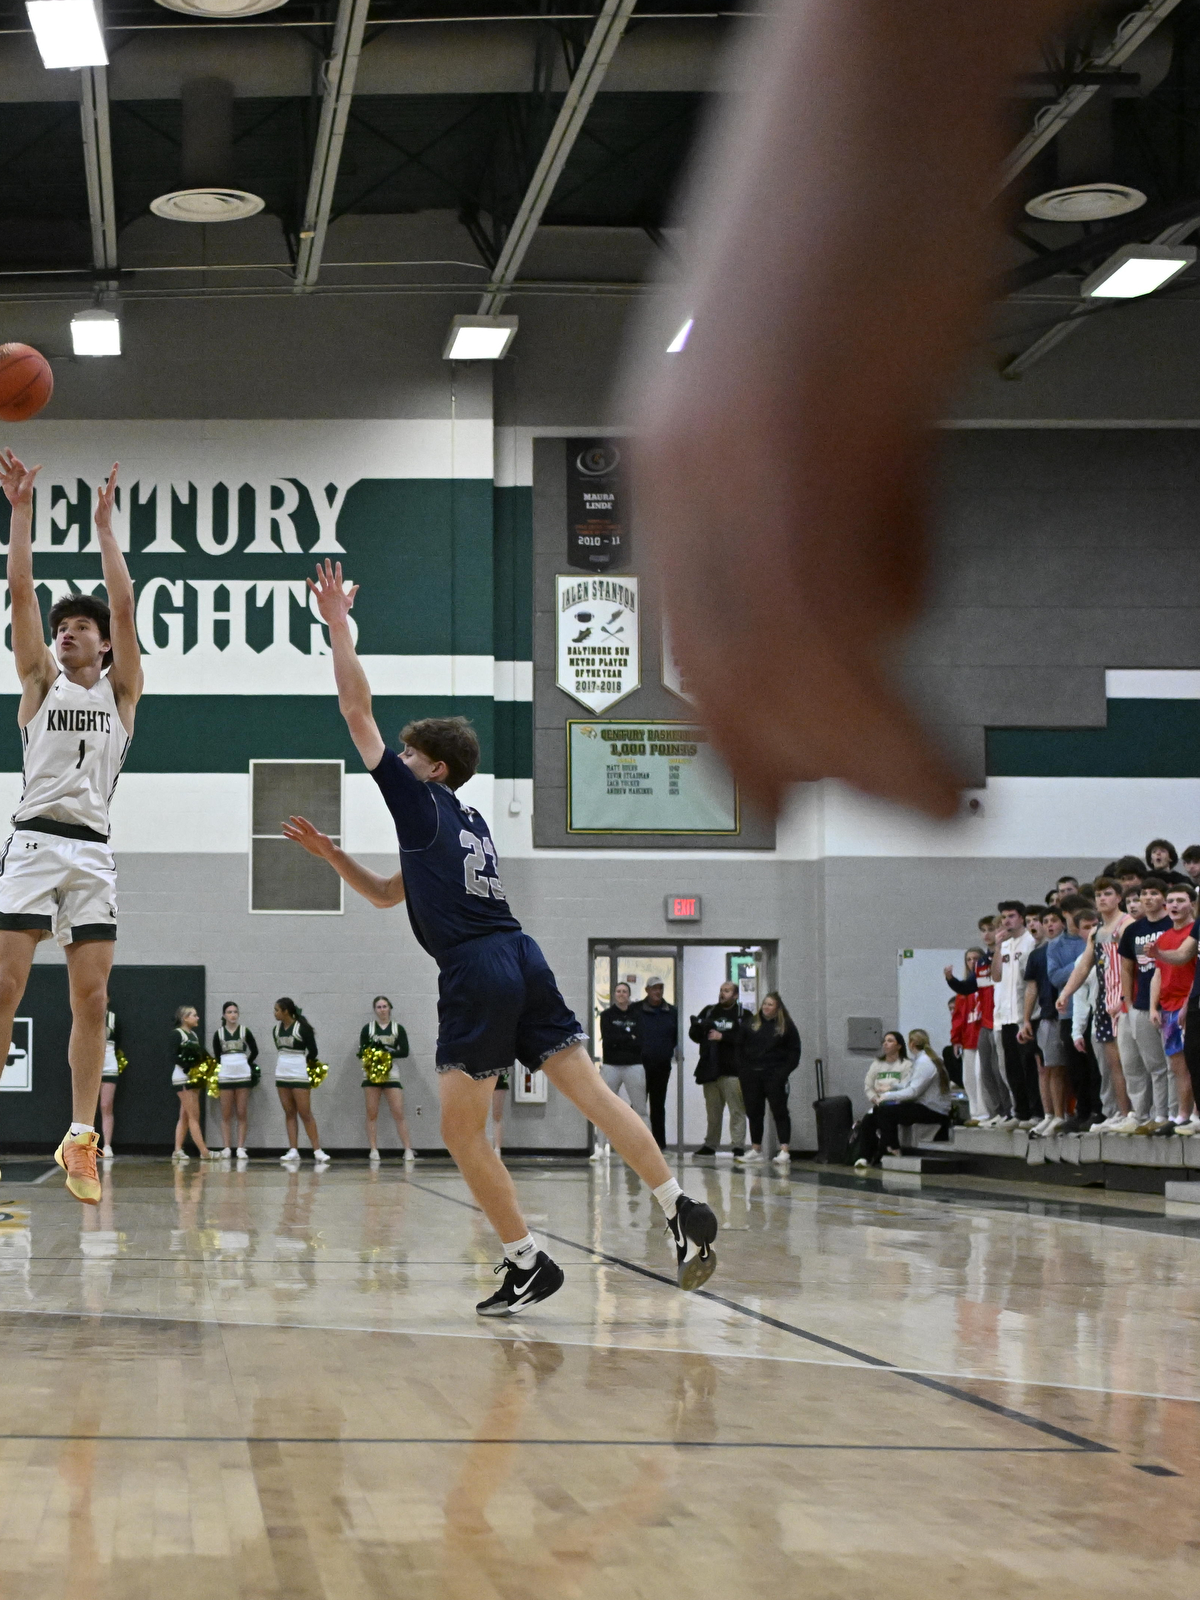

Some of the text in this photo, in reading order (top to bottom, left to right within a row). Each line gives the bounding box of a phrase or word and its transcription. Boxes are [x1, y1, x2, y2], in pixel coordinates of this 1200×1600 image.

[583, 492, 615, 501] MAURA
[578, 535, 601, 546] 2010
[611, 535, 621, 546] 11
[591, 579, 635, 613] STANTON
[567, 646, 630, 656] BALTIMORE SUN
[569, 657, 628, 667] METRO PLAYER
[575, 669, 622, 678] OF THE YEAR
[47, 709, 111, 734] KNIGHTS
[601, 729, 645, 741] CENTURY
[75, 739, 86, 770] 1
[610, 743, 698, 757] 1,000 POINTS
[673, 898, 696, 916] EXIT
